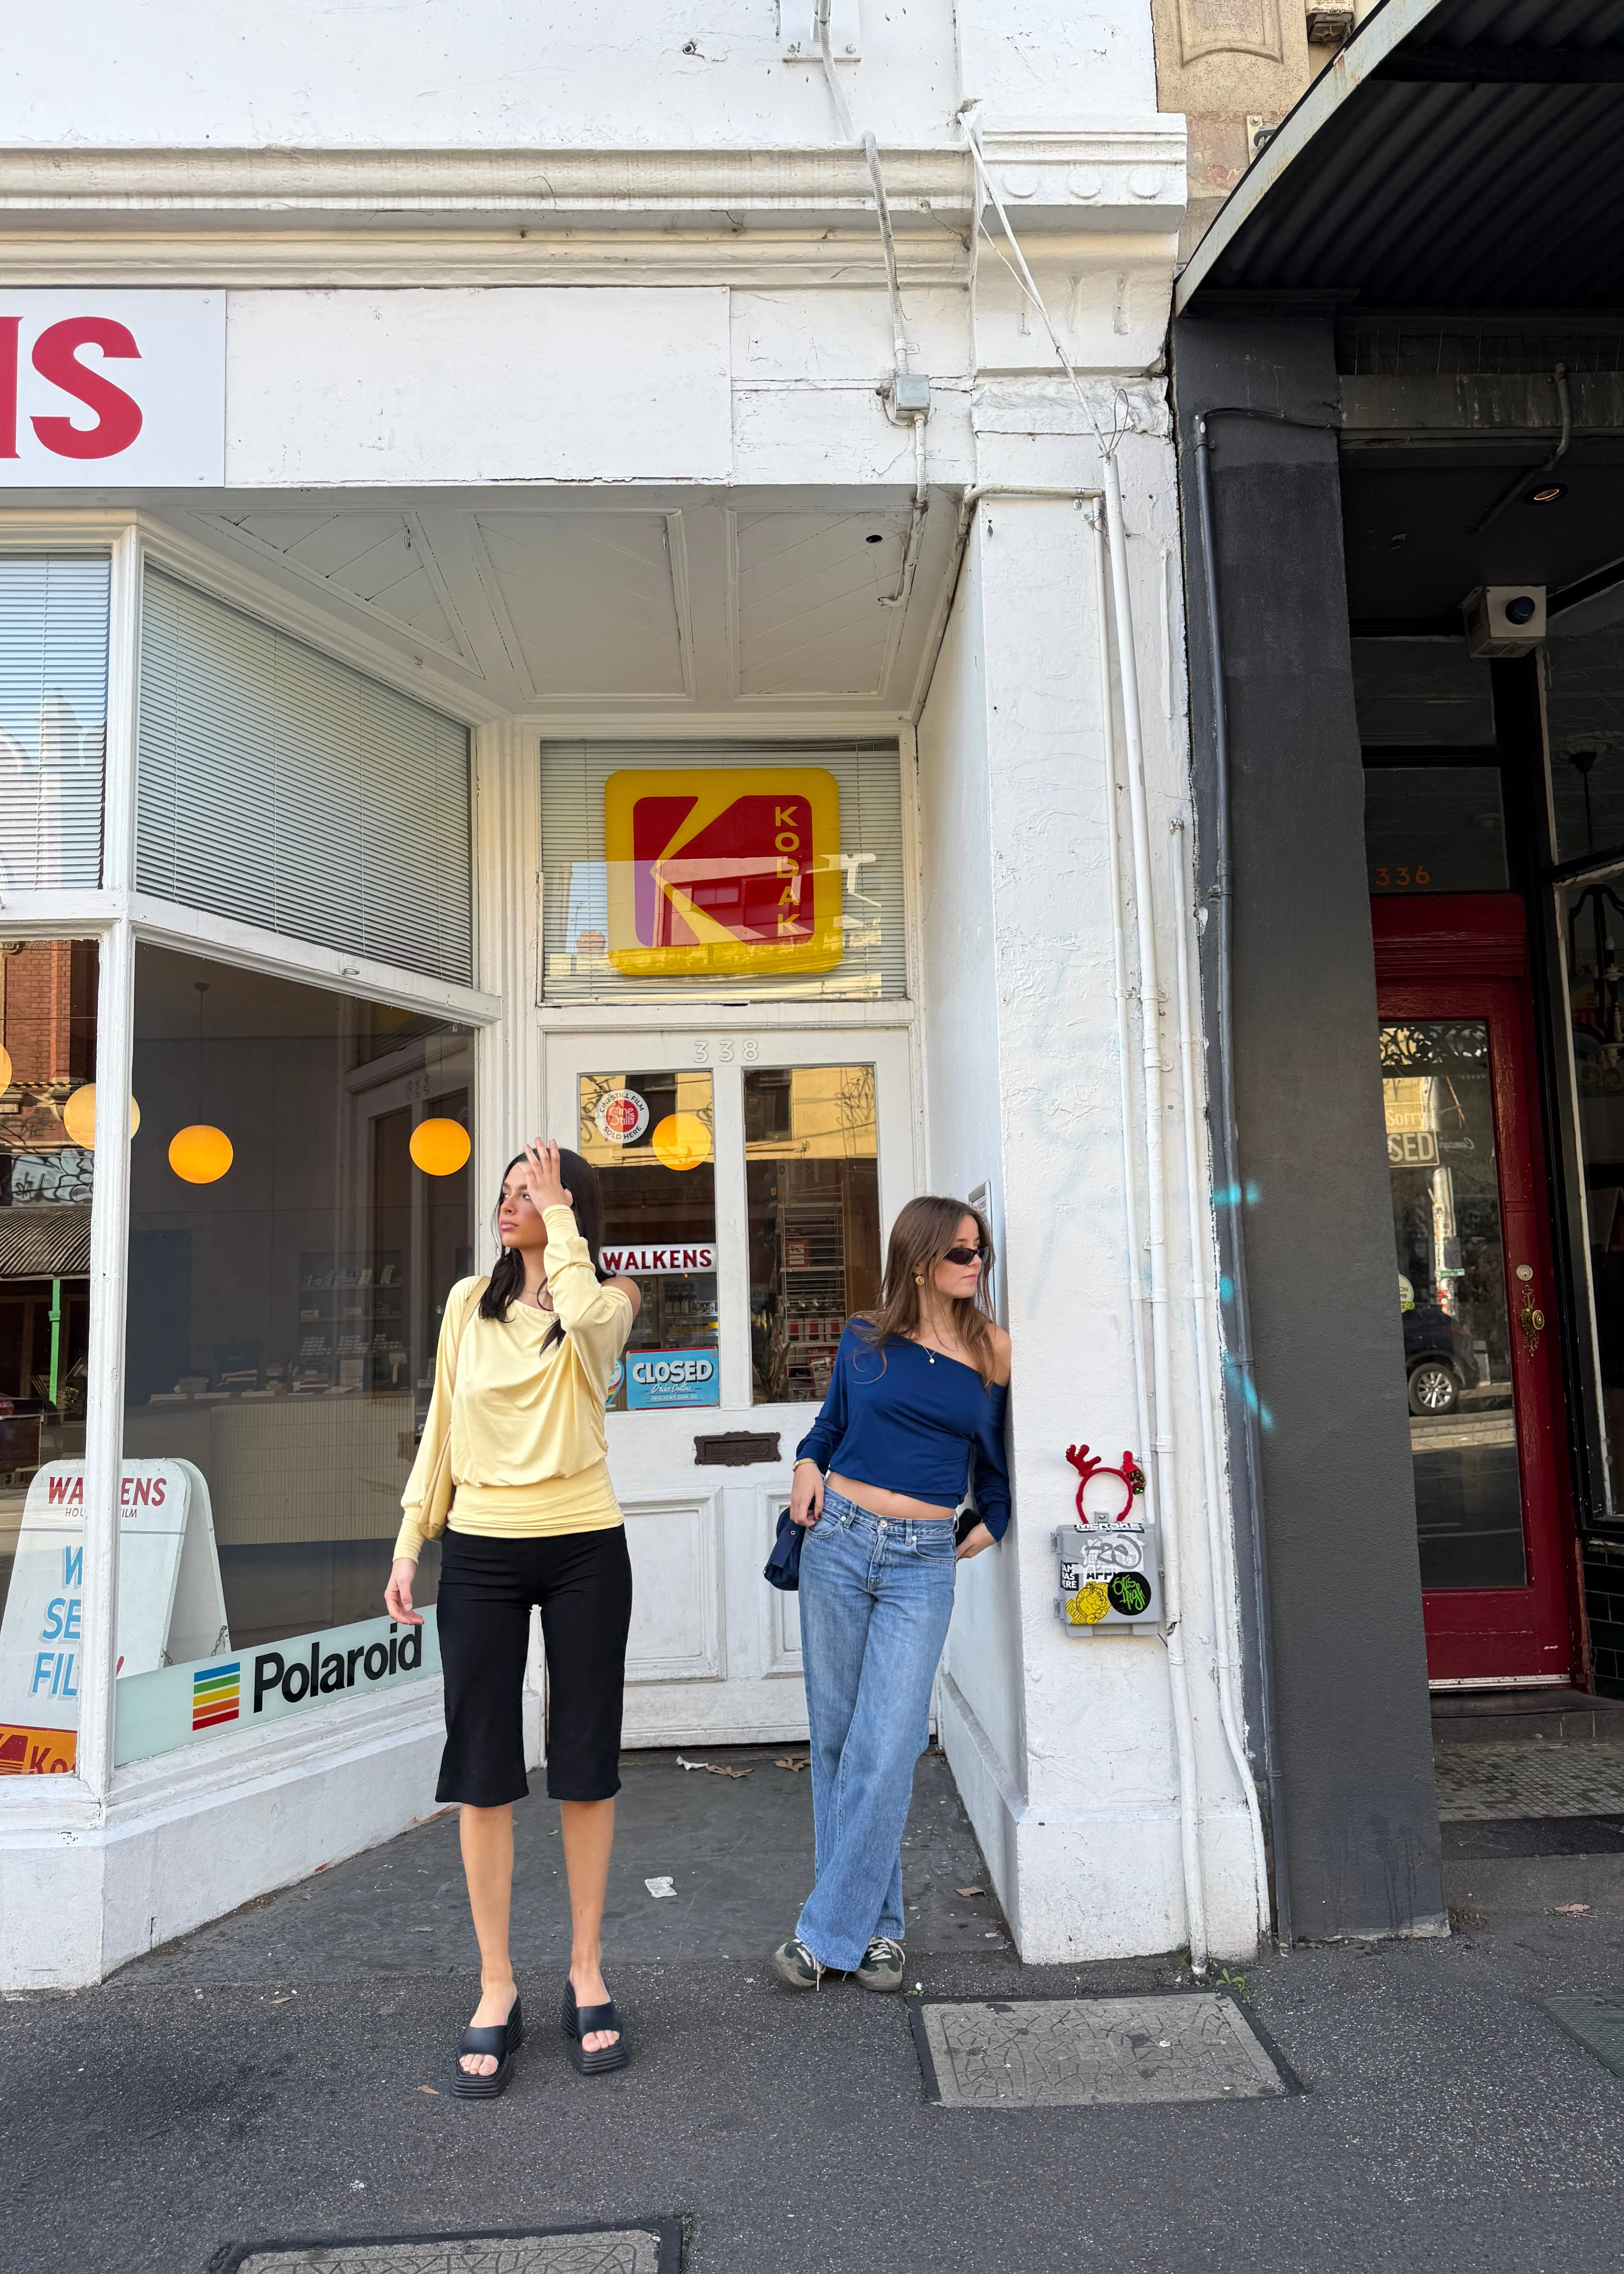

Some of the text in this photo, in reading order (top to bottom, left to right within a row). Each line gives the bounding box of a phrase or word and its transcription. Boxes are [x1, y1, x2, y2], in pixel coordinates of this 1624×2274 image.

[775, 806, 800, 934] KODAK
[1376, 866, 1430, 886] 336
[694, 1039, 759, 1063] 338
[600, 1092, 644, 1113] CINESTILL FILM
[603, 1126, 642, 1139] SOLD HERE
[1388, 1133, 1434, 1162] SED
[602, 1249, 712, 1270] WALKENS
[632, 1360, 714, 1384] CLOSED
[651, 1381, 693, 1394] Order Online
[48, 1477, 167, 1506] WAENS
[121, 1508, 137, 1518] ILM
[42, 1598, 82, 1640] SE
[32, 1652, 78, 1696] FIL
[253, 1622, 422, 1713] Polaroid
[29, 1746, 76, 1774] Ko
